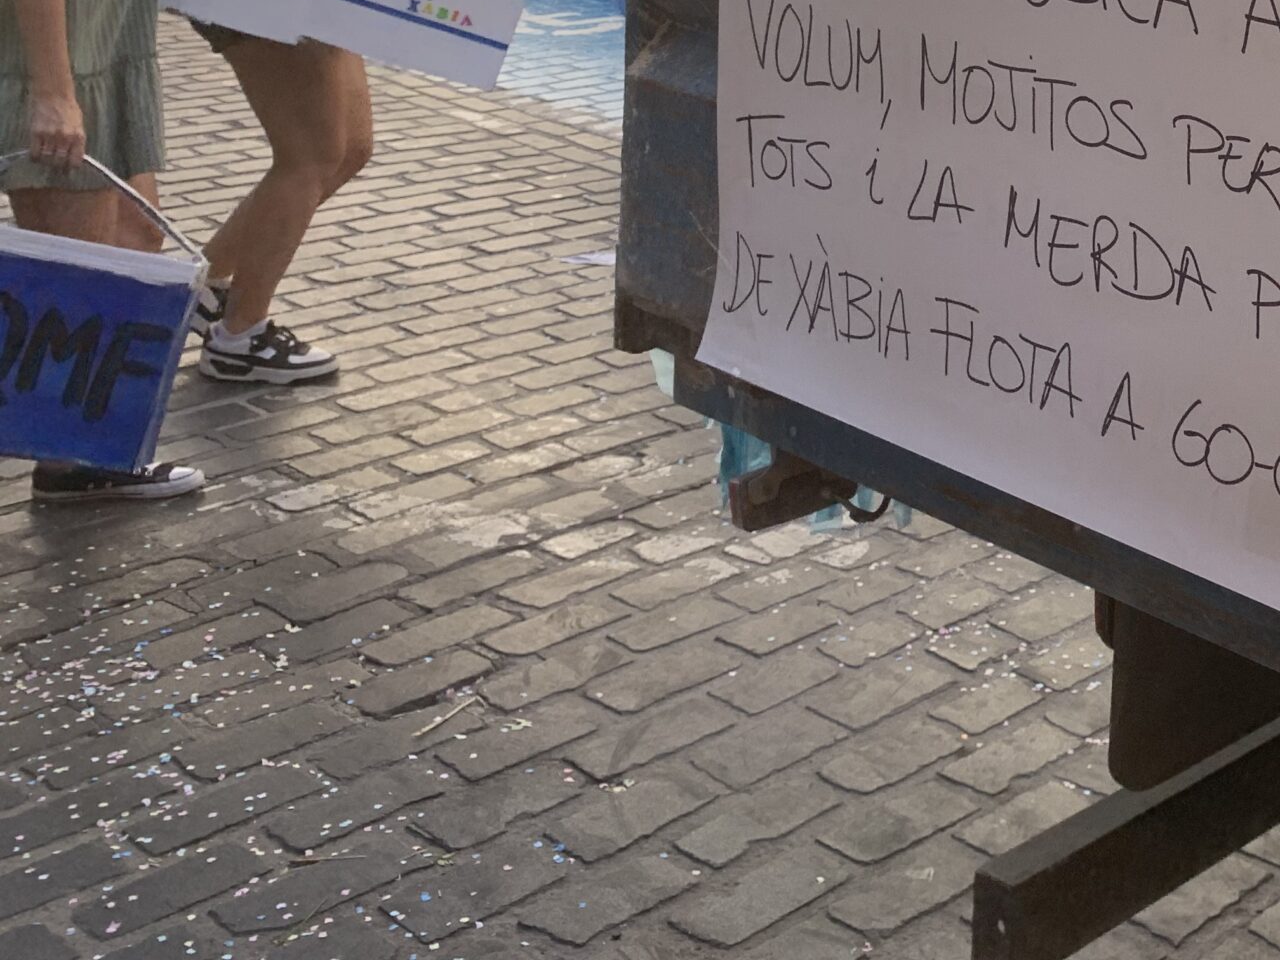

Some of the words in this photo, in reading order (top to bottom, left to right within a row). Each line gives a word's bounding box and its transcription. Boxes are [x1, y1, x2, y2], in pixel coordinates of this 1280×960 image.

[736, 114, 833, 191] TOTS
[907, 159, 975, 224] LA
[1003, 185, 1217, 312] MERDA
[723, 231, 775, 316] DE
[930, 296, 1083, 418] FLOTA
[1101, 371, 1144, 440] A
